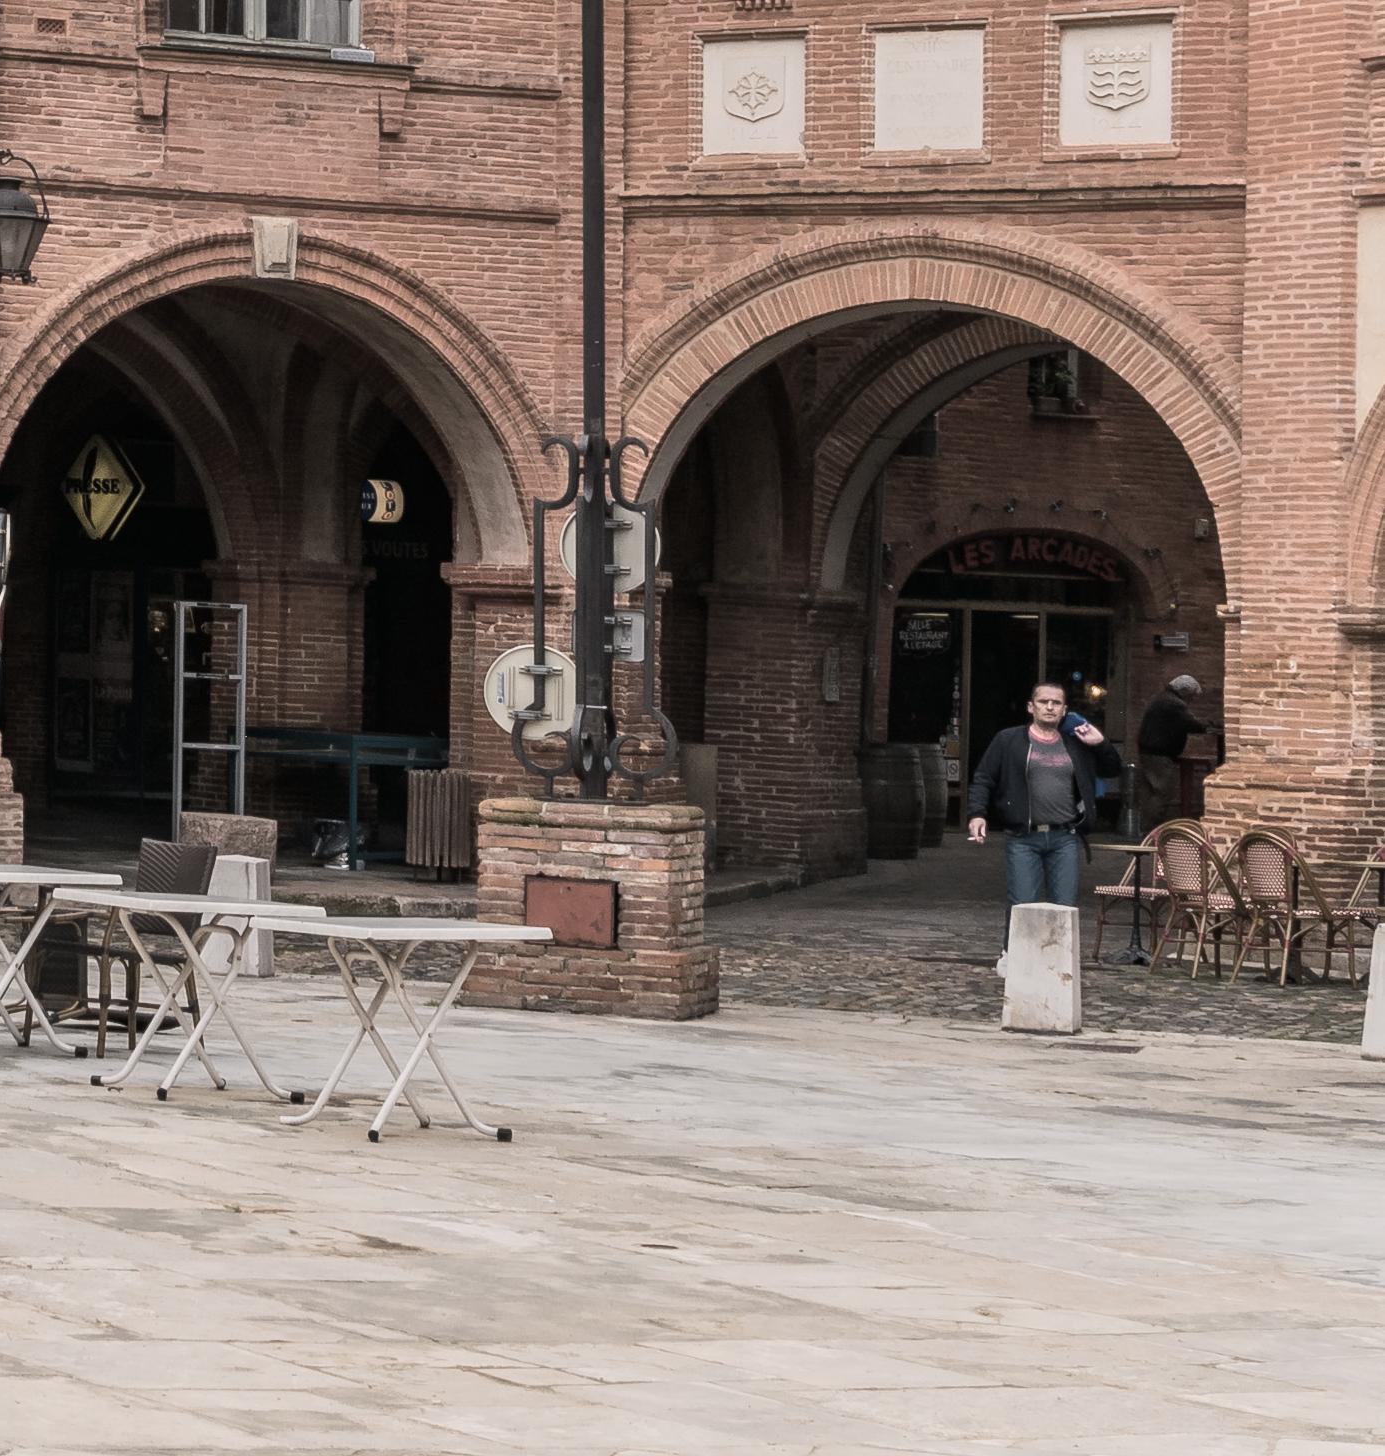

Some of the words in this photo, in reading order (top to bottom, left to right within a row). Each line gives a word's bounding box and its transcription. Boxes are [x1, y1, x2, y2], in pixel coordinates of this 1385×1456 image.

[66, 478, 120, 494] PRESSE
[947, 538, 996, 576] LES
[1010, 536, 1121, 582] ARCADES
